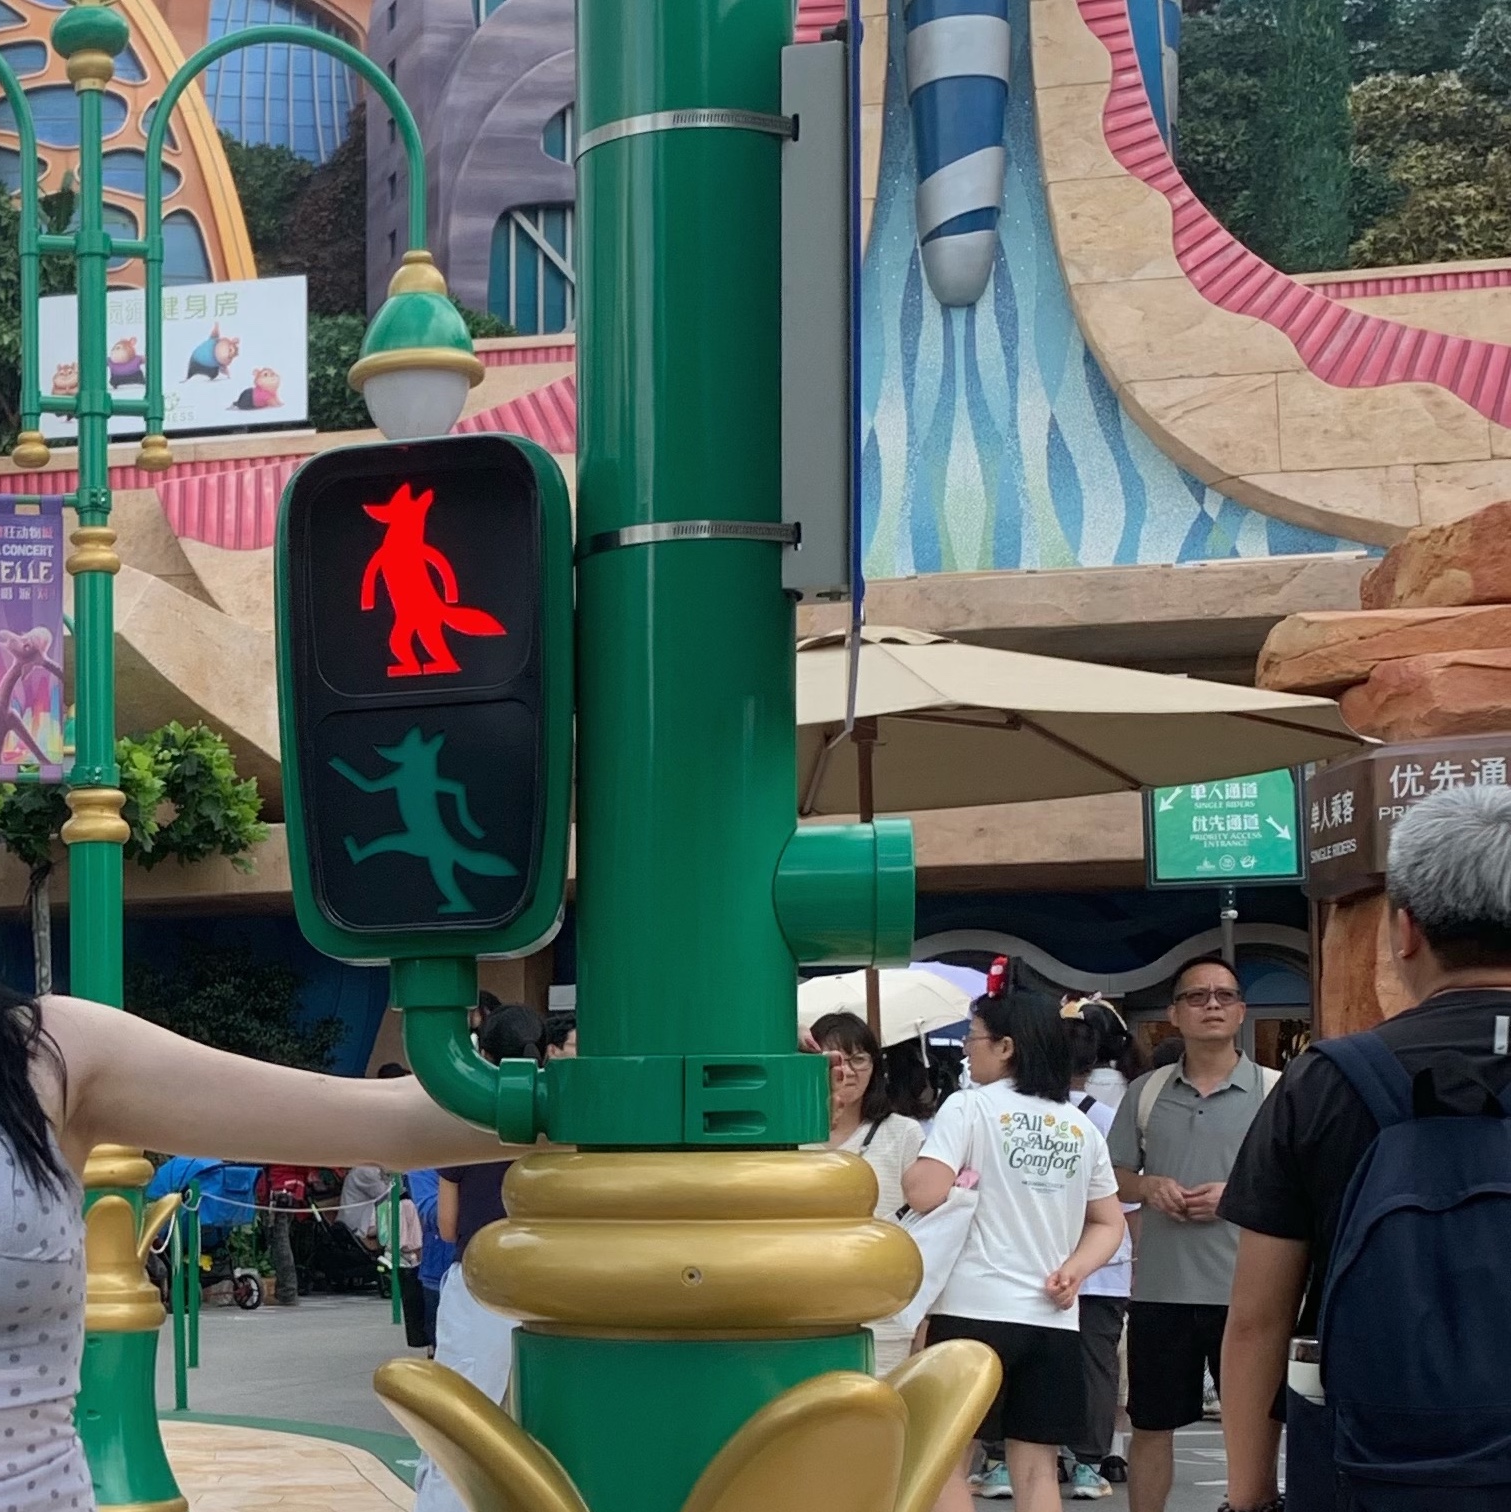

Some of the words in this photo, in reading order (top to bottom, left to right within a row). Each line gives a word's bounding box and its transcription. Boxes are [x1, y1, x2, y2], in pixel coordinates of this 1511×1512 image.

[2, 544, 55, 557] CONCERT
[1310, 789, 1355, 834] 单人乘客
[1190, 832, 1228, 841] PRIORITY
[1230, 831, 1263, 840] ACCESS
[1203, 840, 1249, 848] ENTRANCE
[1012, 1112, 1043, 1132] All
[1028, 1132, 1079, 1155] About
[1008, 1146, 1081, 1177] Comfort
